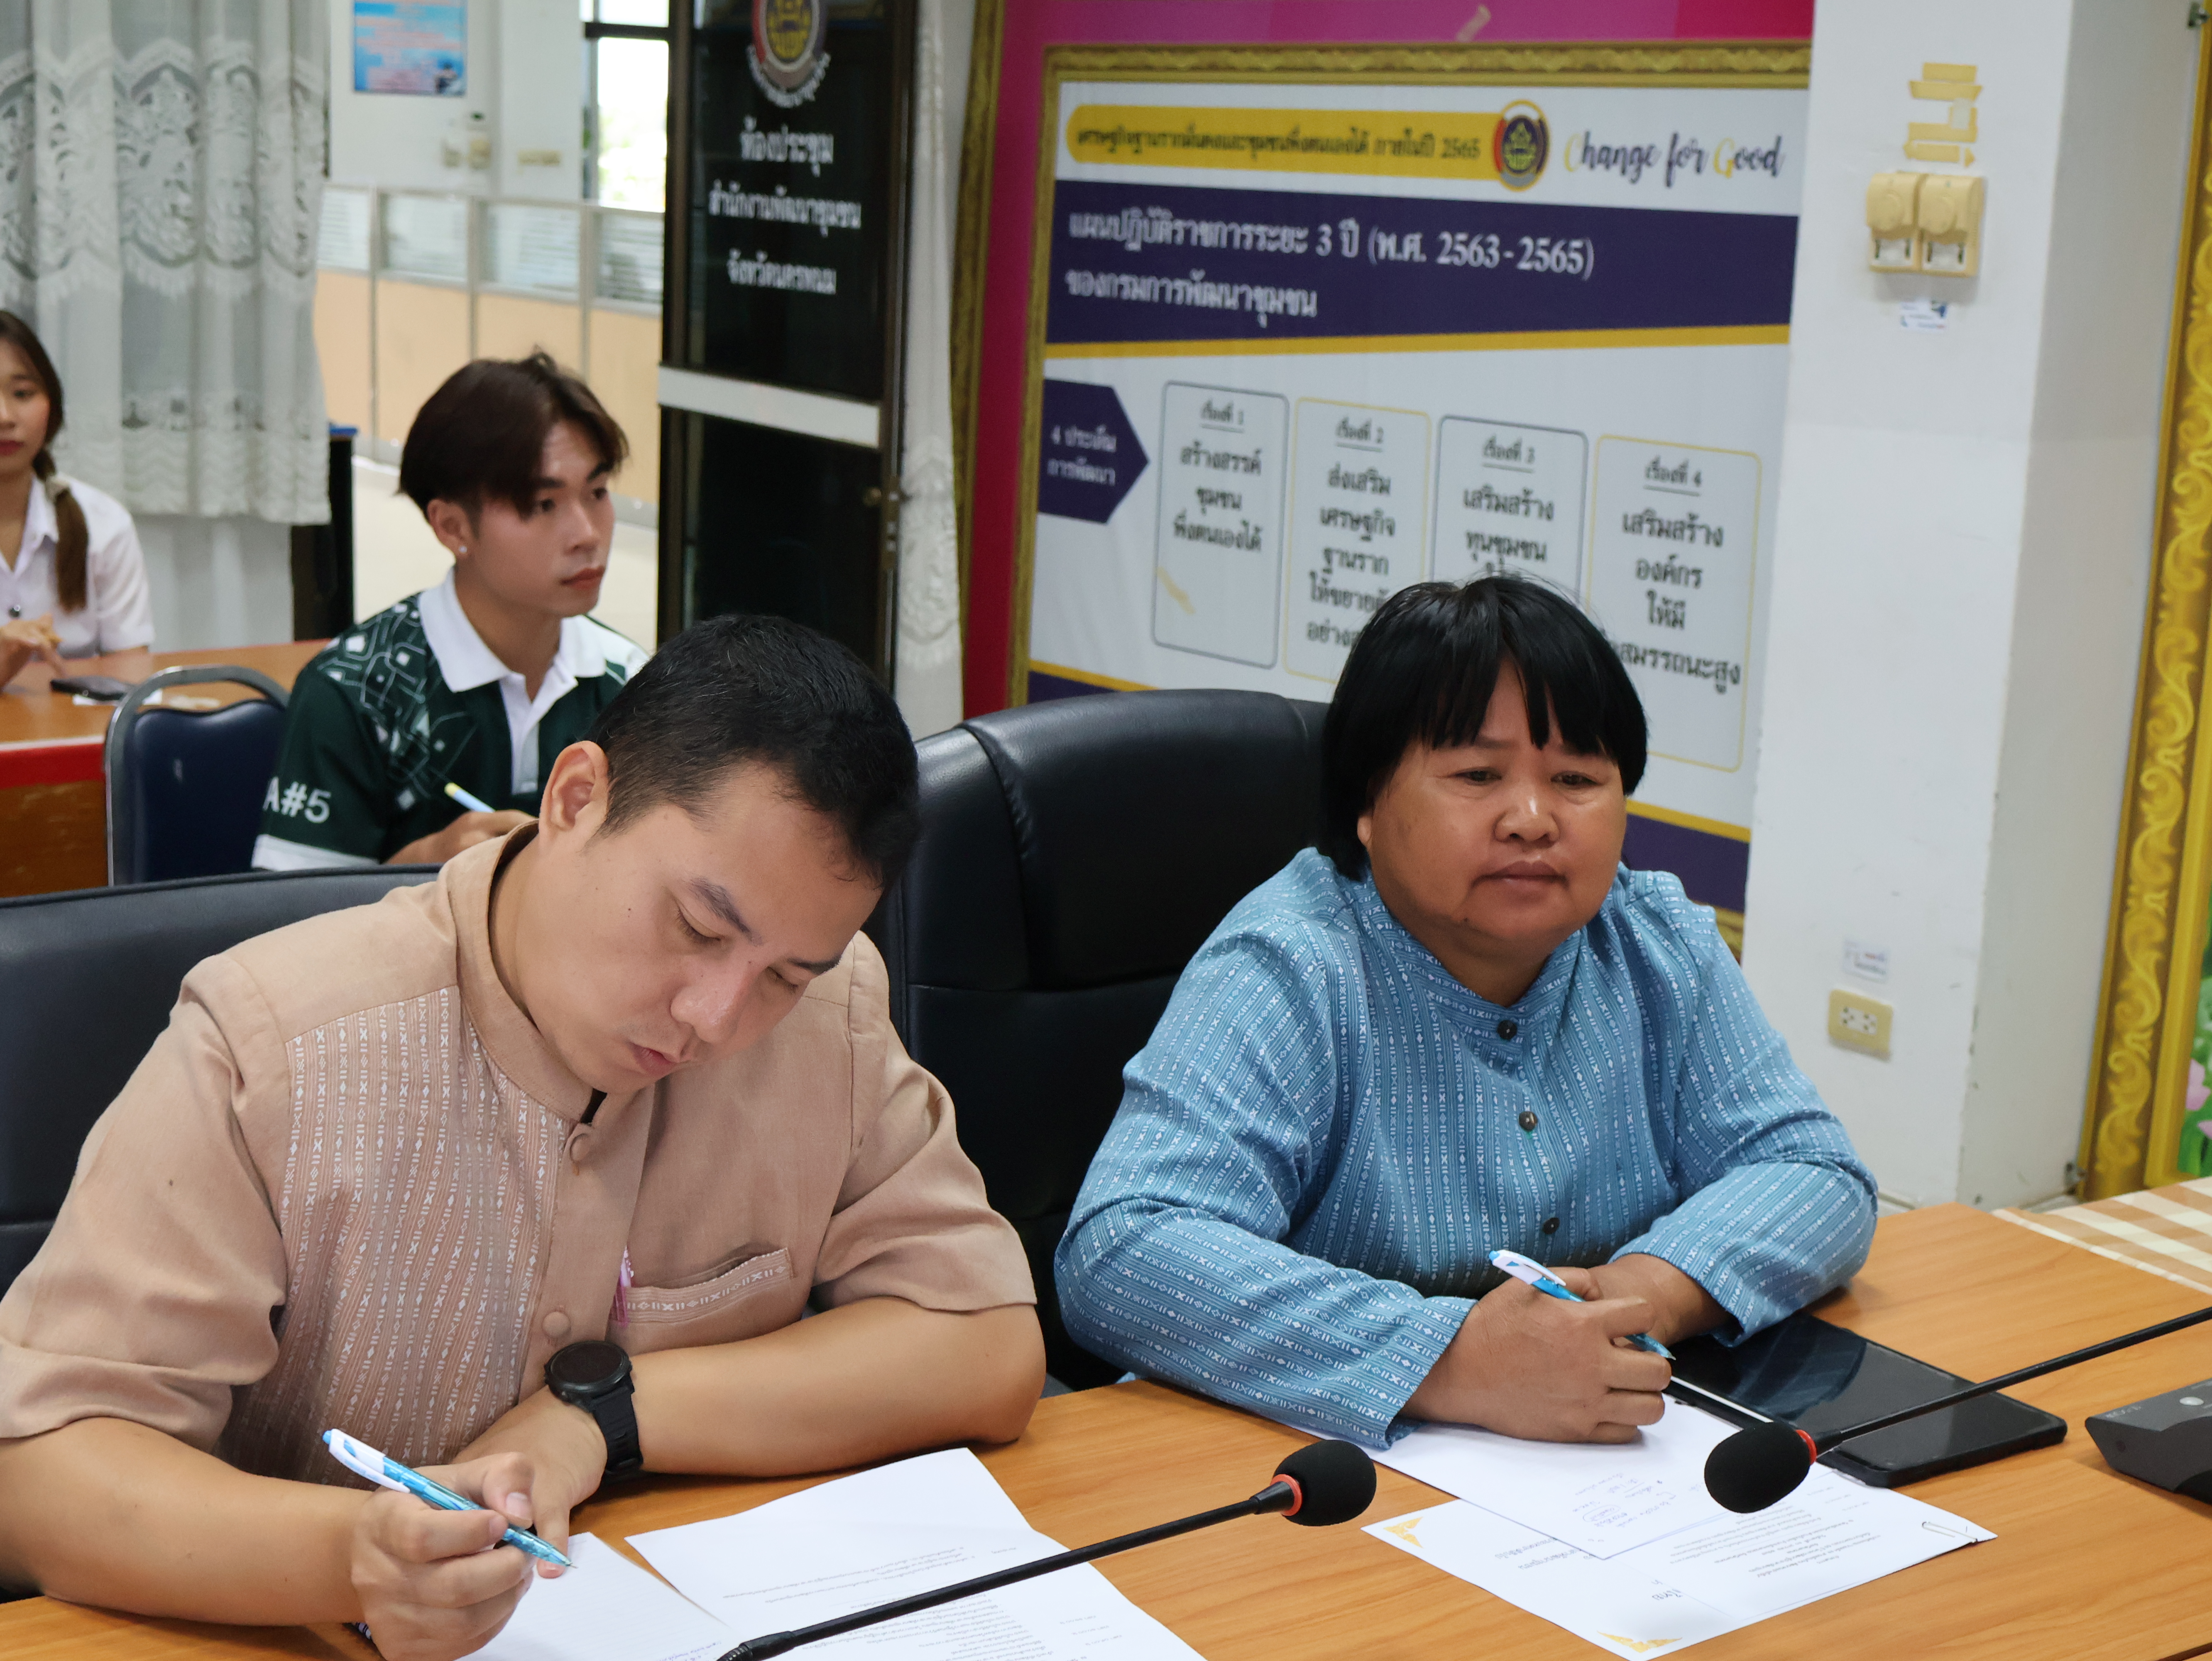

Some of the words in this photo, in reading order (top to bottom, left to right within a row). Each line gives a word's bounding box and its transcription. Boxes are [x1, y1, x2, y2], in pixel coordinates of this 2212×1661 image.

[740, 115, 834, 177] ห้องประชุม
[1440, 137, 1480, 159] 2565
[1565, 131, 1656, 184] Change
[1664, 132, 1705, 188] for
[1714, 135, 1783, 178] Good
[1069, 207, 1309, 253] แผนปฏิบัติราชการระยะ
[1316, 224, 1332, 256] 3
[1338, 217, 1360, 258] ปี
[1368, 227, 1427, 265] (พ.ศ.
[1065, 269, 1317, 328] ของกรมการพัฒนาชุมชน
[1238, 410, 1244, 425] 1
[1376, 427, 1384, 444] 2
[1180, 439, 1262, 475] สร้างสรรค์
[1527, 447, 1535, 464] 3
[1327, 463, 1391, 495] ส่งเสริม
[1693, 472, 1702, 487] 4
[1196, 487, 1242, 514] ชุมชน
[1463, 484, 1554, 522] เสริมสร้าง
[1172, 507, 1262, 551] พึ่งตนเองได้
[1319, 507, 1396, 541] เศรษฐกิจ
[1622, 508, 1724, 548] เสริมสร้าง
[1321, 544, 1389, 574] ฐานราก
[1466, 531, 1547, 565] ทุนชุมชน
[1635, 553, 1703, 589] องค์กร
[1646, 589, 1686, 630] ให้มี
